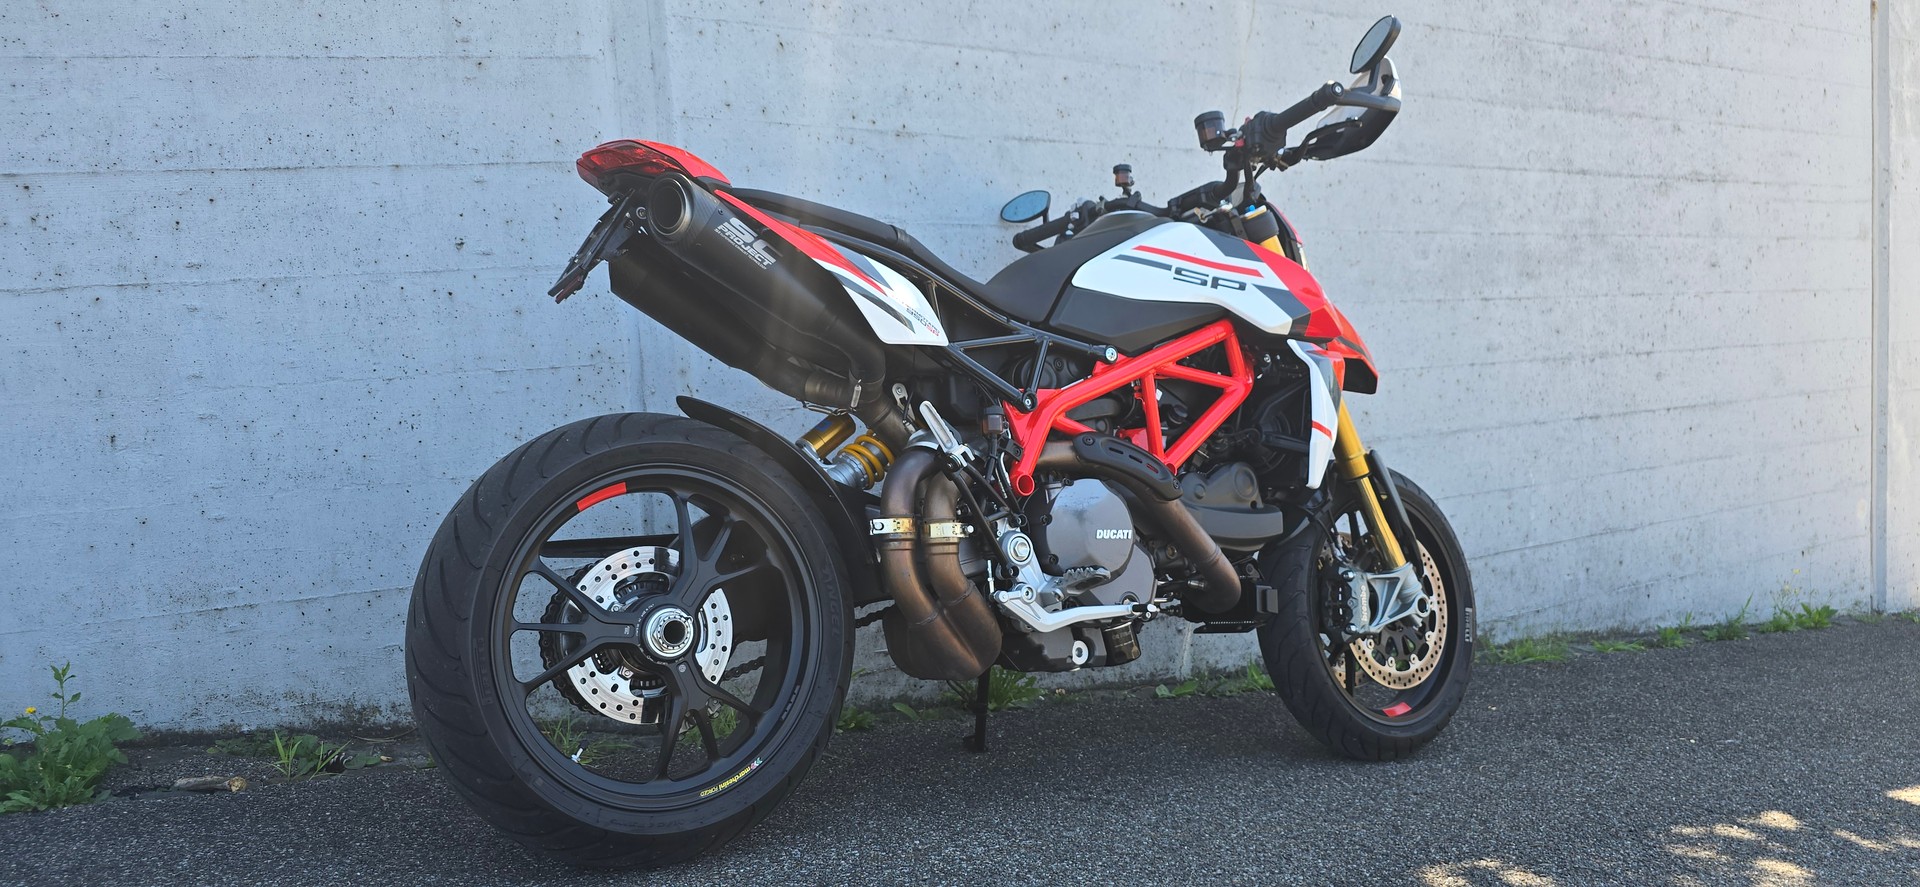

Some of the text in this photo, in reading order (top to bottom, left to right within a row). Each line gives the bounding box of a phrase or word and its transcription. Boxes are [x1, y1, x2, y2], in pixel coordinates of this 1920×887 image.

[717, 224, 773, 266] PROJECT
[722, 217, 783, 264] SC
[1173, 266, 1247, 291] SP
[1096, 529, 1133, 540] DUCATI
[1360, 585, 1368, 621] brembo
[719, 766, 751, 791] marchesini
